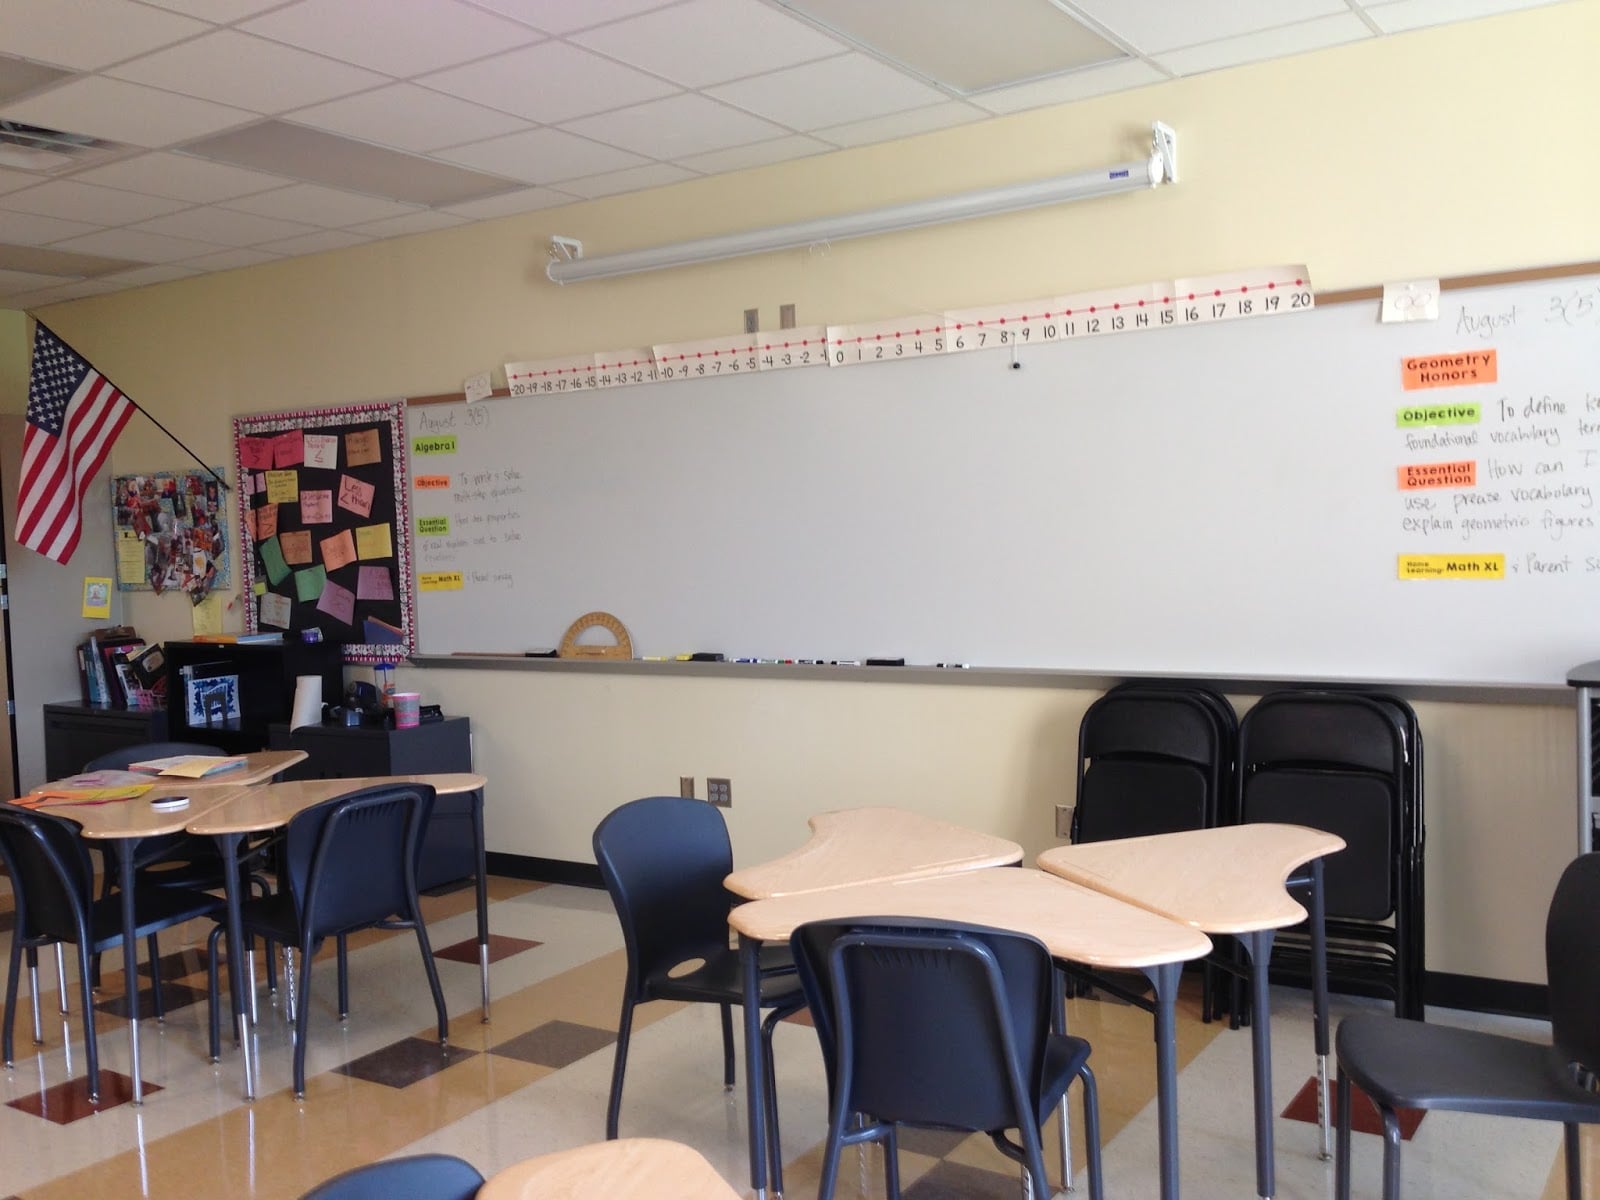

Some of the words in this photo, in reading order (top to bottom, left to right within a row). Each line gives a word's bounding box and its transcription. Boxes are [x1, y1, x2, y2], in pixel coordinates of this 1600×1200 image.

[836, 351, 844, 363] 0
[875, 347, 883, 359] 2
[895, 344, 903, 356] 3
[915, 341, 923, 353] 4
[935, 339, 943, 351] 5
[956, 336, 965, 348] 6
[978, 333, 986, 346] 7
[1000, 331, 1008, 343] 8
[1022, 328, 1030, 341] 9
[1043, 325, 1056, 338] 10
[1065, 322, 1075, 335] 11
[1087, 320, 1100, 333] 12
[1111, 317, 1125, 330] 13
[1135, 313, 1149, 327] 14
[1160, 310, 1174, 324] 15
[1185, 307, 1199, 321] 16
[1212, 303, 1226, 318] 17
[1238, 300, 1253, 314] 18
[1265, 296, 1280, 310] 19
[1291, 293, 1311, 308] 20
[1407, 353, 1490, 371] Geometry
[1420, 369, 1478, 383] Honors
[1403, 407, 1475, 422] Objective
[1498, 397, 1515, 422] To
[1523, 396, 1566, 418] define
[415, 440, 450, 453] Algebra
[1407, 463, 1471, 477] Essential
[1488, 458, 1523, 480] How
[1535, 460, 1563, 476] can
[417, 479, 448, 487] Objective
[1407, 475, 1471, 487] Question
[1405, 497, 1436, 510] use
[419, 518, 447, 526] Essential
[1402, 514, 1454, 536] explain
[1461, 513, 1530, 541] geometric
[1542, 509, 1594, 541] figures
[419, 526, 447, 534] Question
[1446, 561, 1480, 572] Math
[1484, 561, 1499, 571] XL
[1526, 552, 1572, 574] Parent
